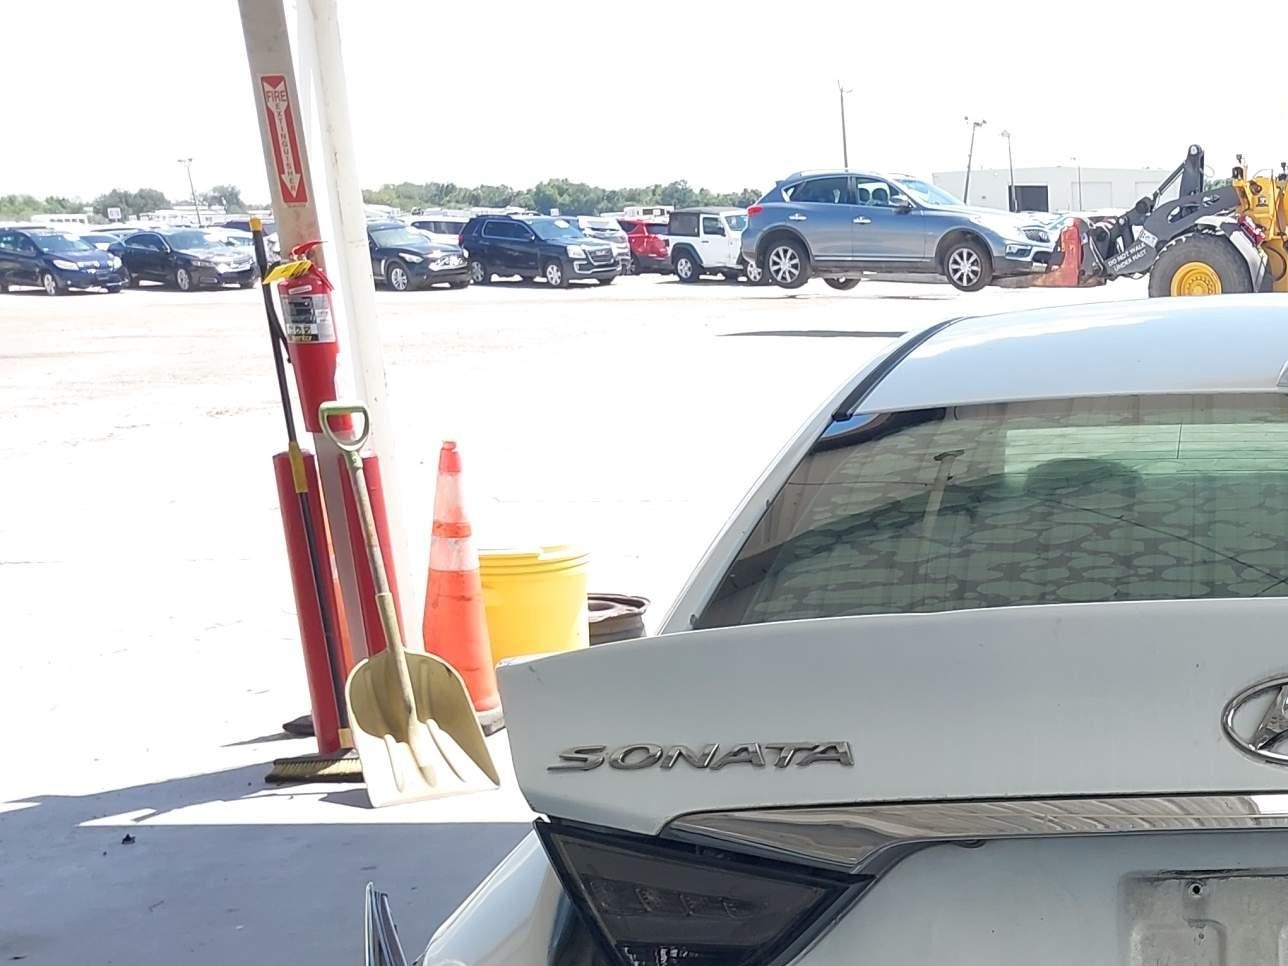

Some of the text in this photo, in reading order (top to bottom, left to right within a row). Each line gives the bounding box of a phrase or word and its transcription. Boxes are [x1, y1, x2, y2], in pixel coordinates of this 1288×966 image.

[266, 90, 288, 102] FIRE
[275, 103, 296, 191] EXTINGUISHER
[1108, 242, 1146, 267] DO NOT WALK
[1113, 258, 1132, 272] UNDER
[547, 740, 855, 771] SONATA
